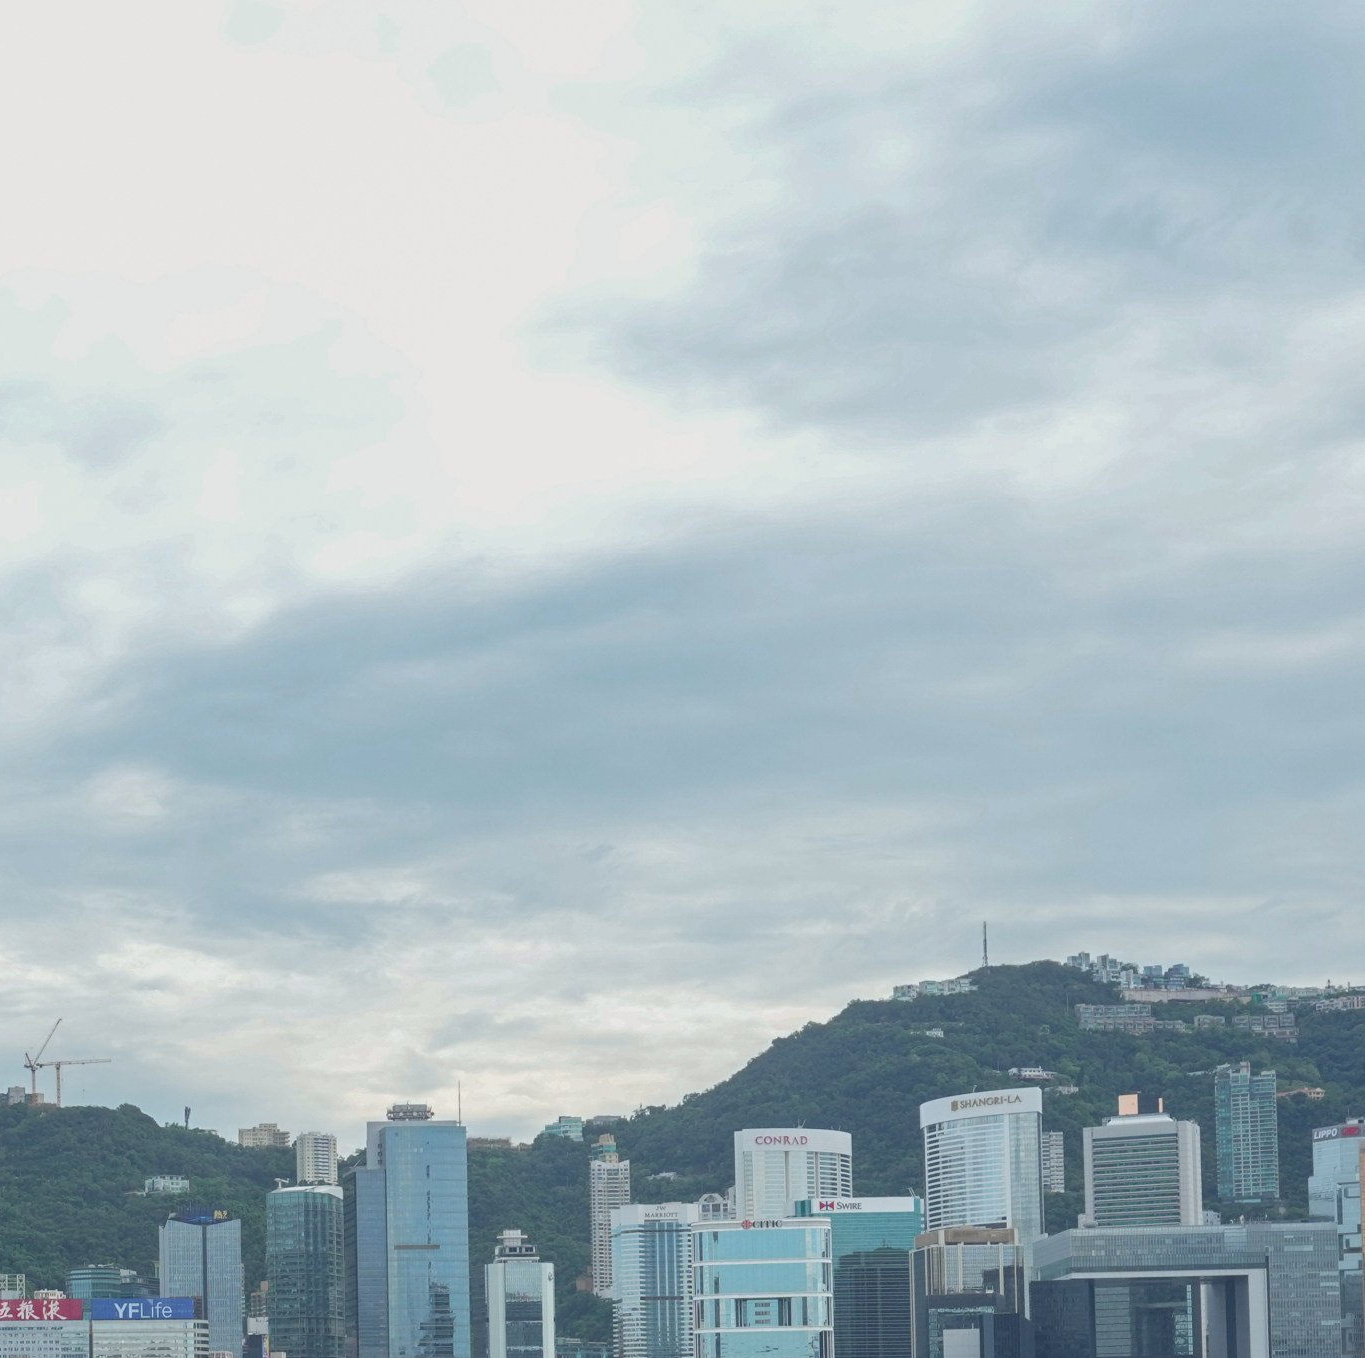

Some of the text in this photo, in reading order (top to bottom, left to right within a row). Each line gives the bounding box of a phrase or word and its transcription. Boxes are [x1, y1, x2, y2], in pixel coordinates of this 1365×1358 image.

[960, 1094, 1022, 1109] SHANGRI-LA
[1314, 1128, 1338, 1140] LIPPO
[755, 1136, 808, 1145] CONRAD
[752, 1219, 783, 1229] CITIC
